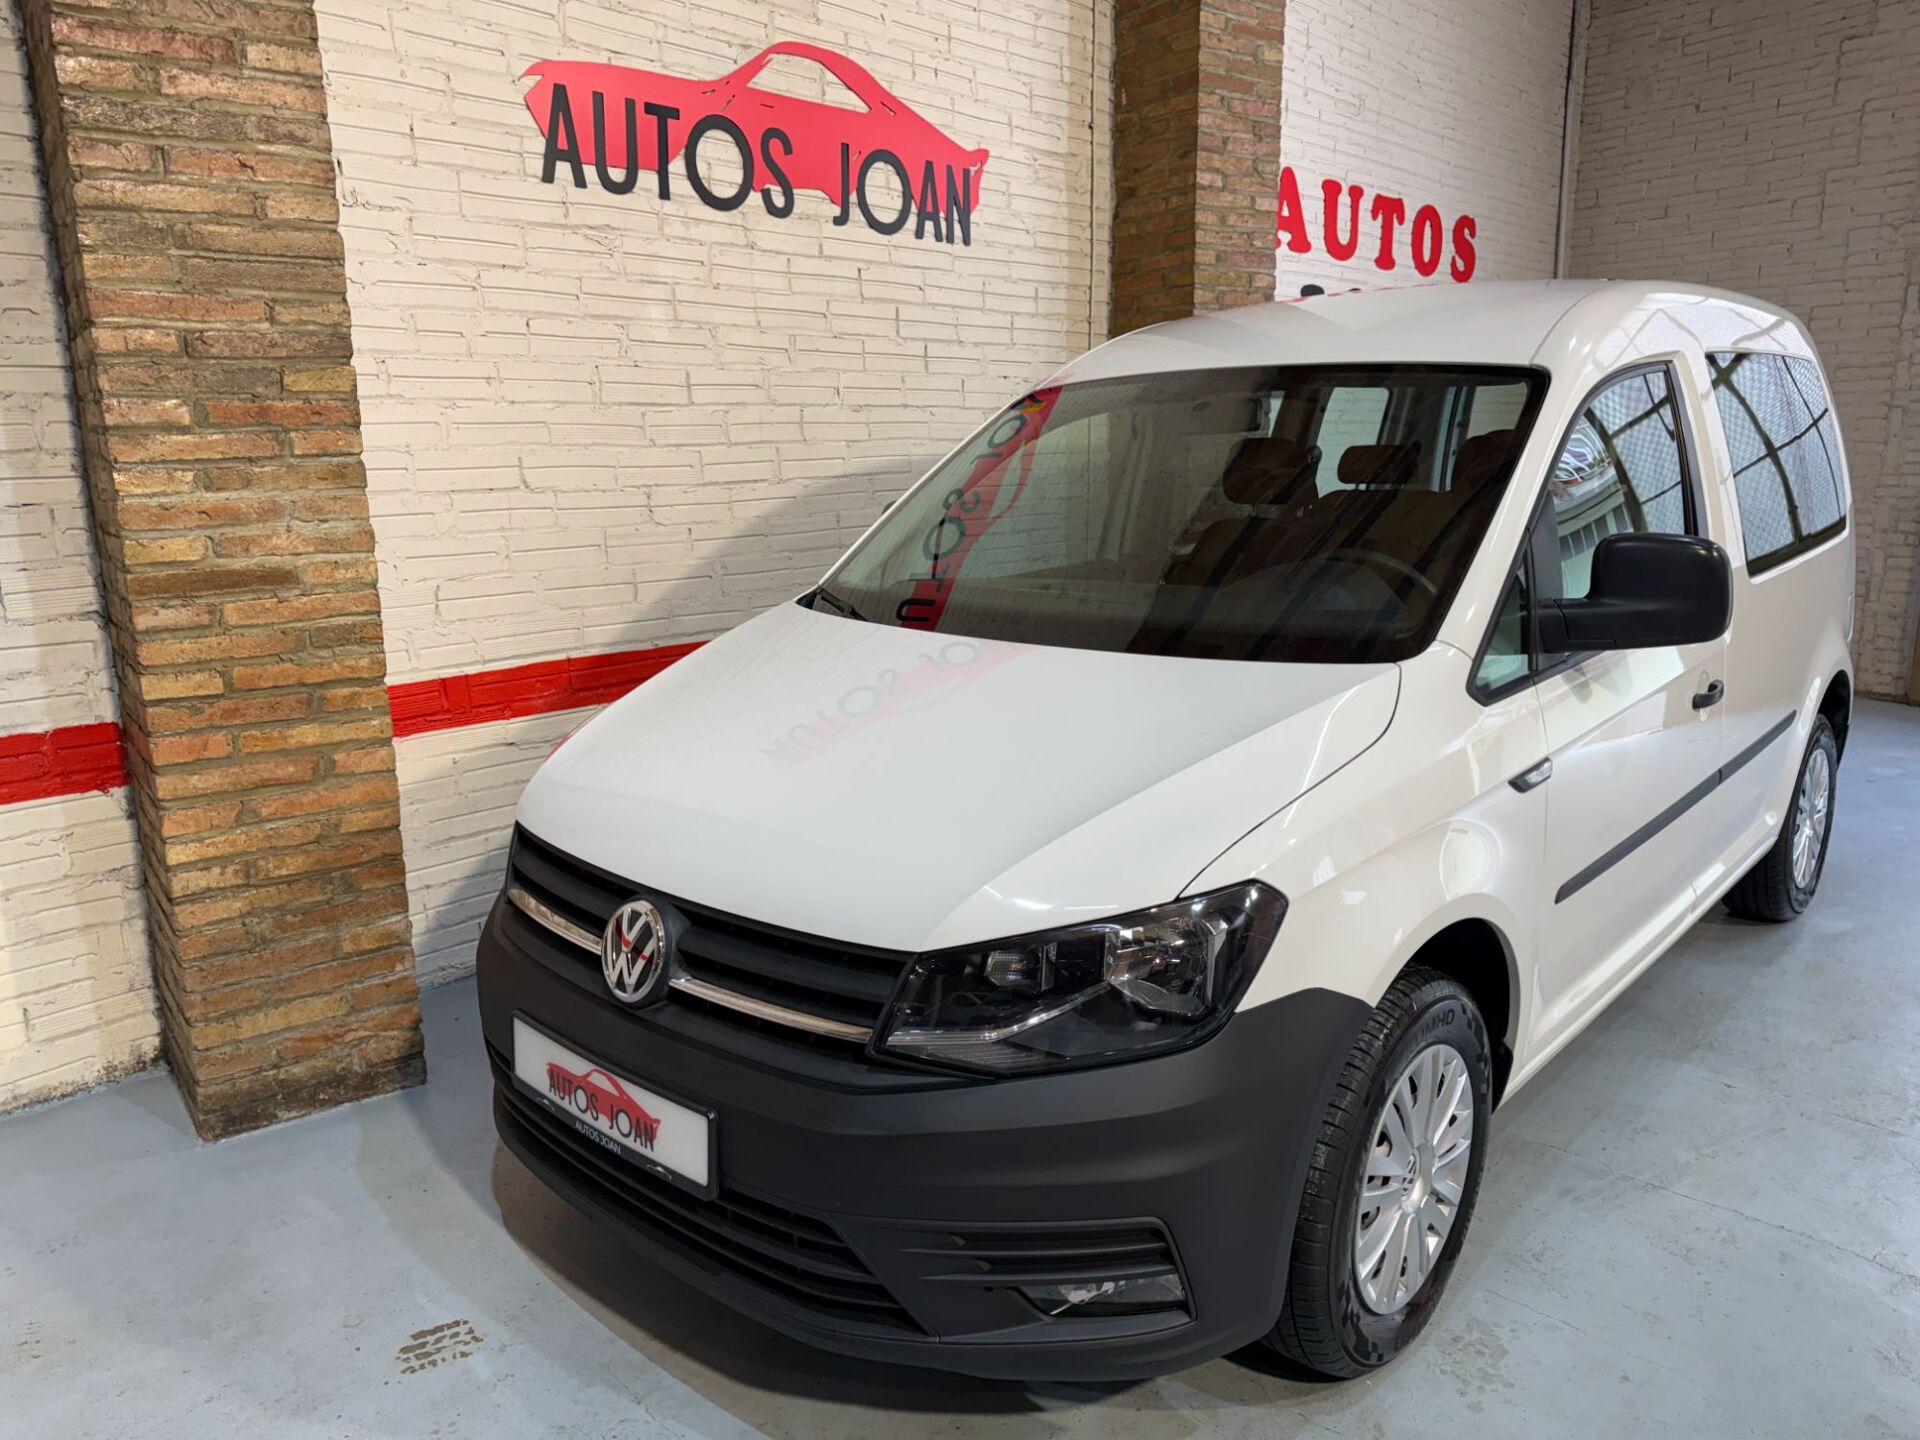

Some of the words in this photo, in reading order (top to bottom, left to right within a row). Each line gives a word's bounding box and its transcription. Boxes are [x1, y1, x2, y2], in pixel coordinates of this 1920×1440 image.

[541, 82, 795, 219] AUTOS
[832, 141, 972, 247] JOAN
[1275, 166, 1477, 283] AUTOS
[548, 1068, 600, 1122] AUTOS
[608, 1103, 656, 1152] JOAN
[575, 1120, 600, 1143] AUTOS
[600, 1134, 621, 1155] JOAN
